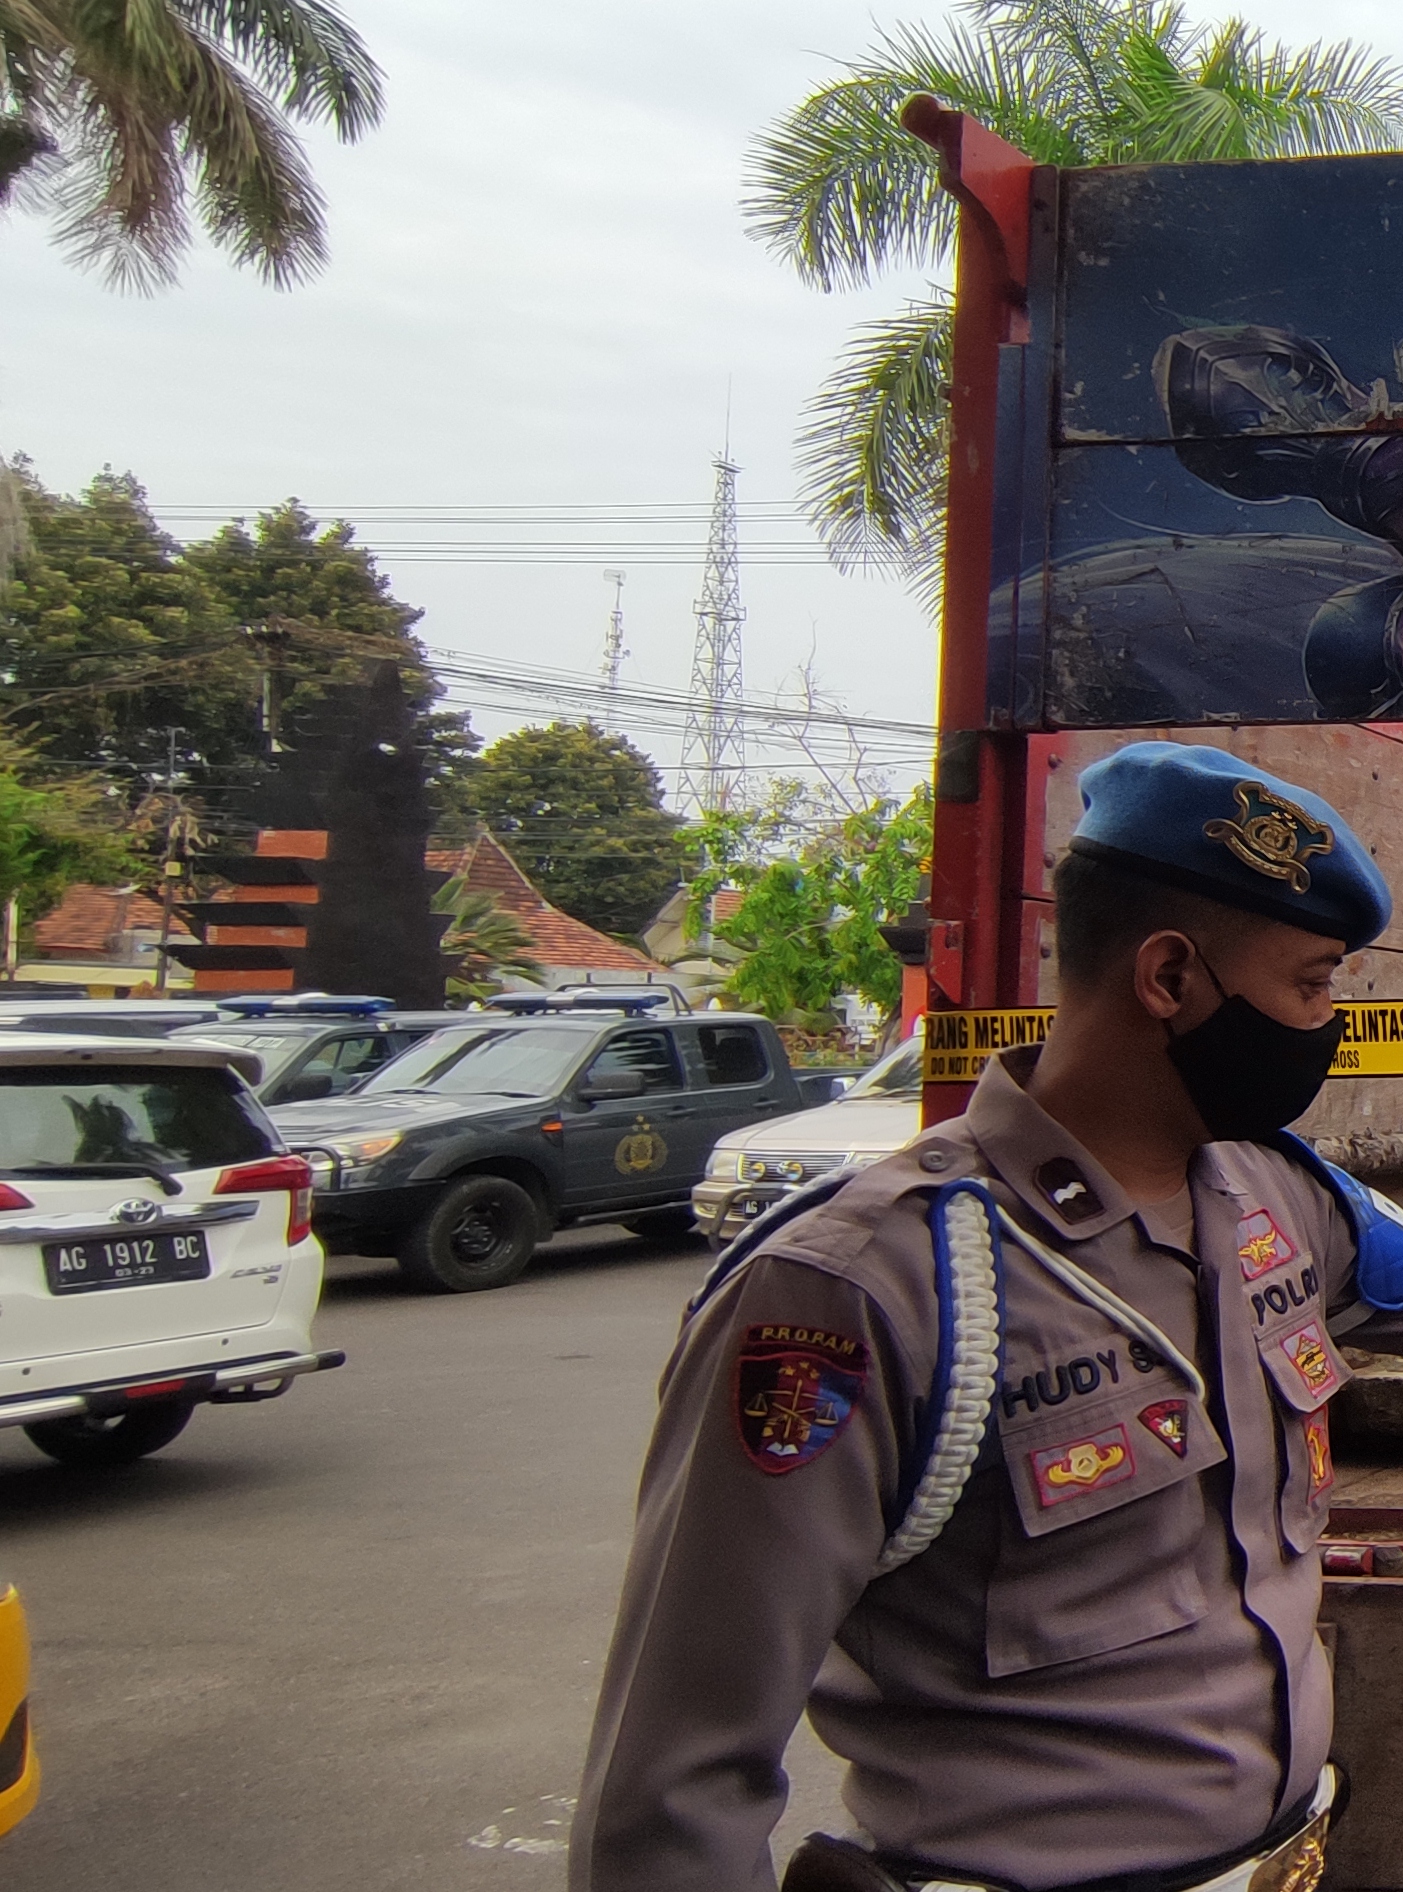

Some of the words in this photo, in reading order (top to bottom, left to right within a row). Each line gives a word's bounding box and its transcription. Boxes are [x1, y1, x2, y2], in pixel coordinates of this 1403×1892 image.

[931, 1056, 945, 1075] DO
[948, 1056, 968, 1075] NOT
[1332, 1049, 1360, 1069] ROSS
[59, 1248, 87, 1272] AG
[104, 1239, 158, 1267] 1912
[173, 1236, 200, 1260] BC
[1251, 1264, 1319, 1326] POLRI
[1002, 1349, 1119, 1418] HUDY
